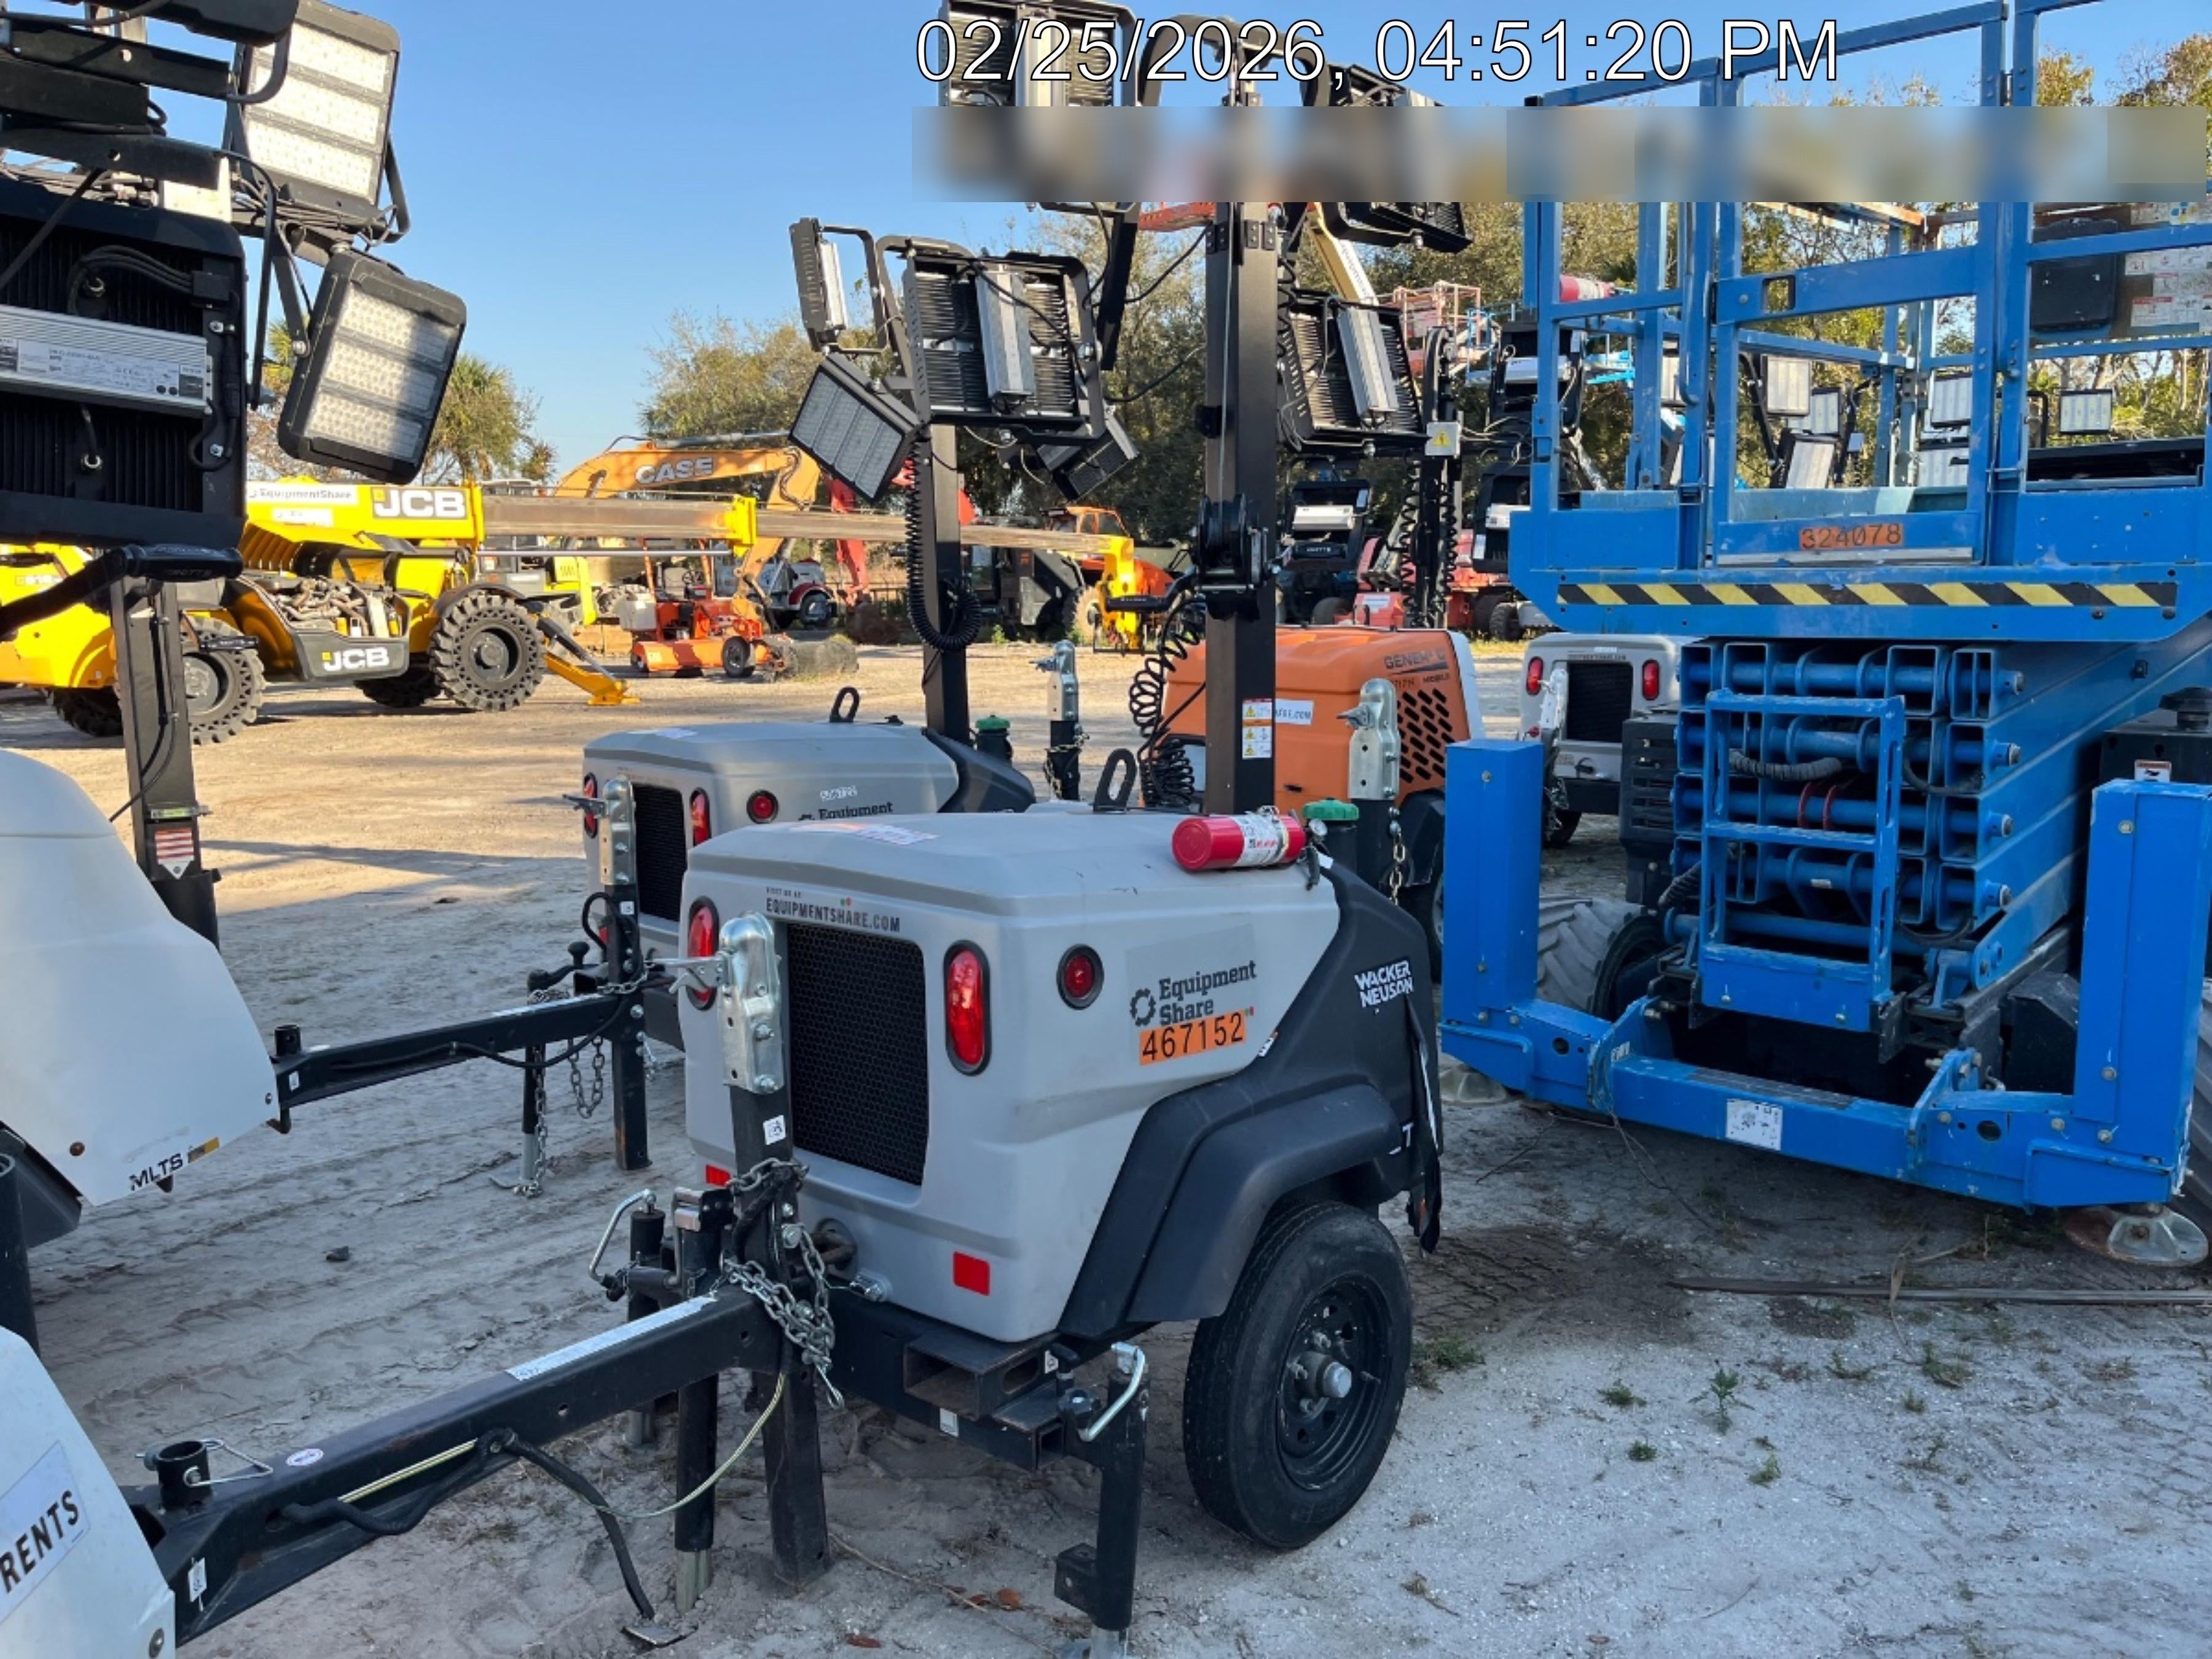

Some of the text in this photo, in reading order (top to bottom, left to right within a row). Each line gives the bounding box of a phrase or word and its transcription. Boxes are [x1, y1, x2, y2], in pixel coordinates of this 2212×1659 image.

[635, 457, 713, 484] CASE
[259, 487, 352, 500] EquipmentShare
[374, 489, 466, 518] JCB
[1802, 523, 1902, 549] 324078
[322, 647, 390, 672] JCB
[766, 897, 901, 933] EQUIPMENTSHARE.COM
[1159, 960, 1257, 1002] Equipment
[1354, 960, 1411, 990] WACKER
[1360, 976, 1413, 1008] NEUSON
[1159, 998, 1214, 1026] Share
[1142, 1012, 1244, 1061] 467152
[129, 1153, 183, 1191] MLTS
[0, 1489, 79, 1593] RENTS
